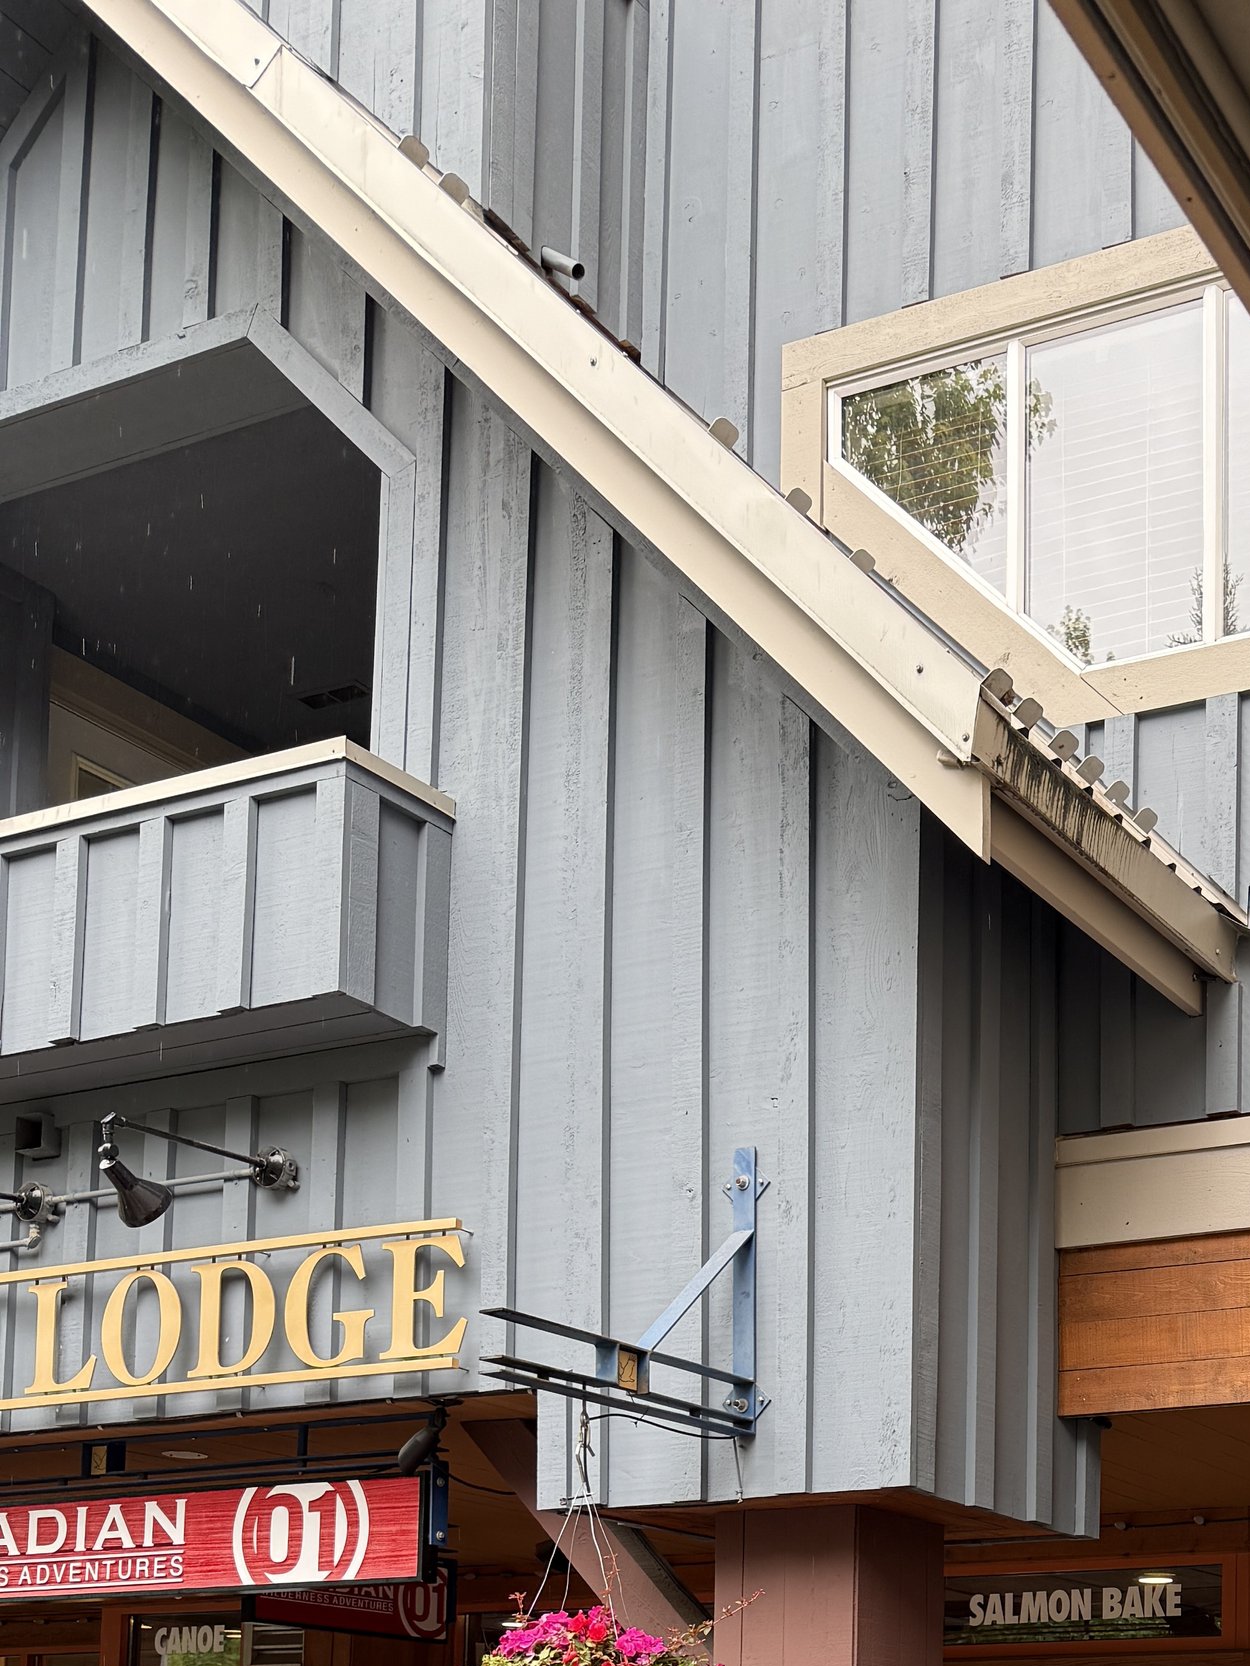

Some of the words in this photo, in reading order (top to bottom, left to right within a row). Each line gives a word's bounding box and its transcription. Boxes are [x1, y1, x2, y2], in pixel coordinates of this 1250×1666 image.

[24, 1235, 468, 1395] LODGE
[18, 1555, 184, 1586] ADVENTURES
[261, 1590, 330, 1604] ILDERNESS
[332, 1596, 394, 1612] ADVENTURES
[969, 1588, 1092, 1627] SALMON
[1102, 1583, 1182, 1620] BAKE
[154, 1624, 225, 1656] CANOE
